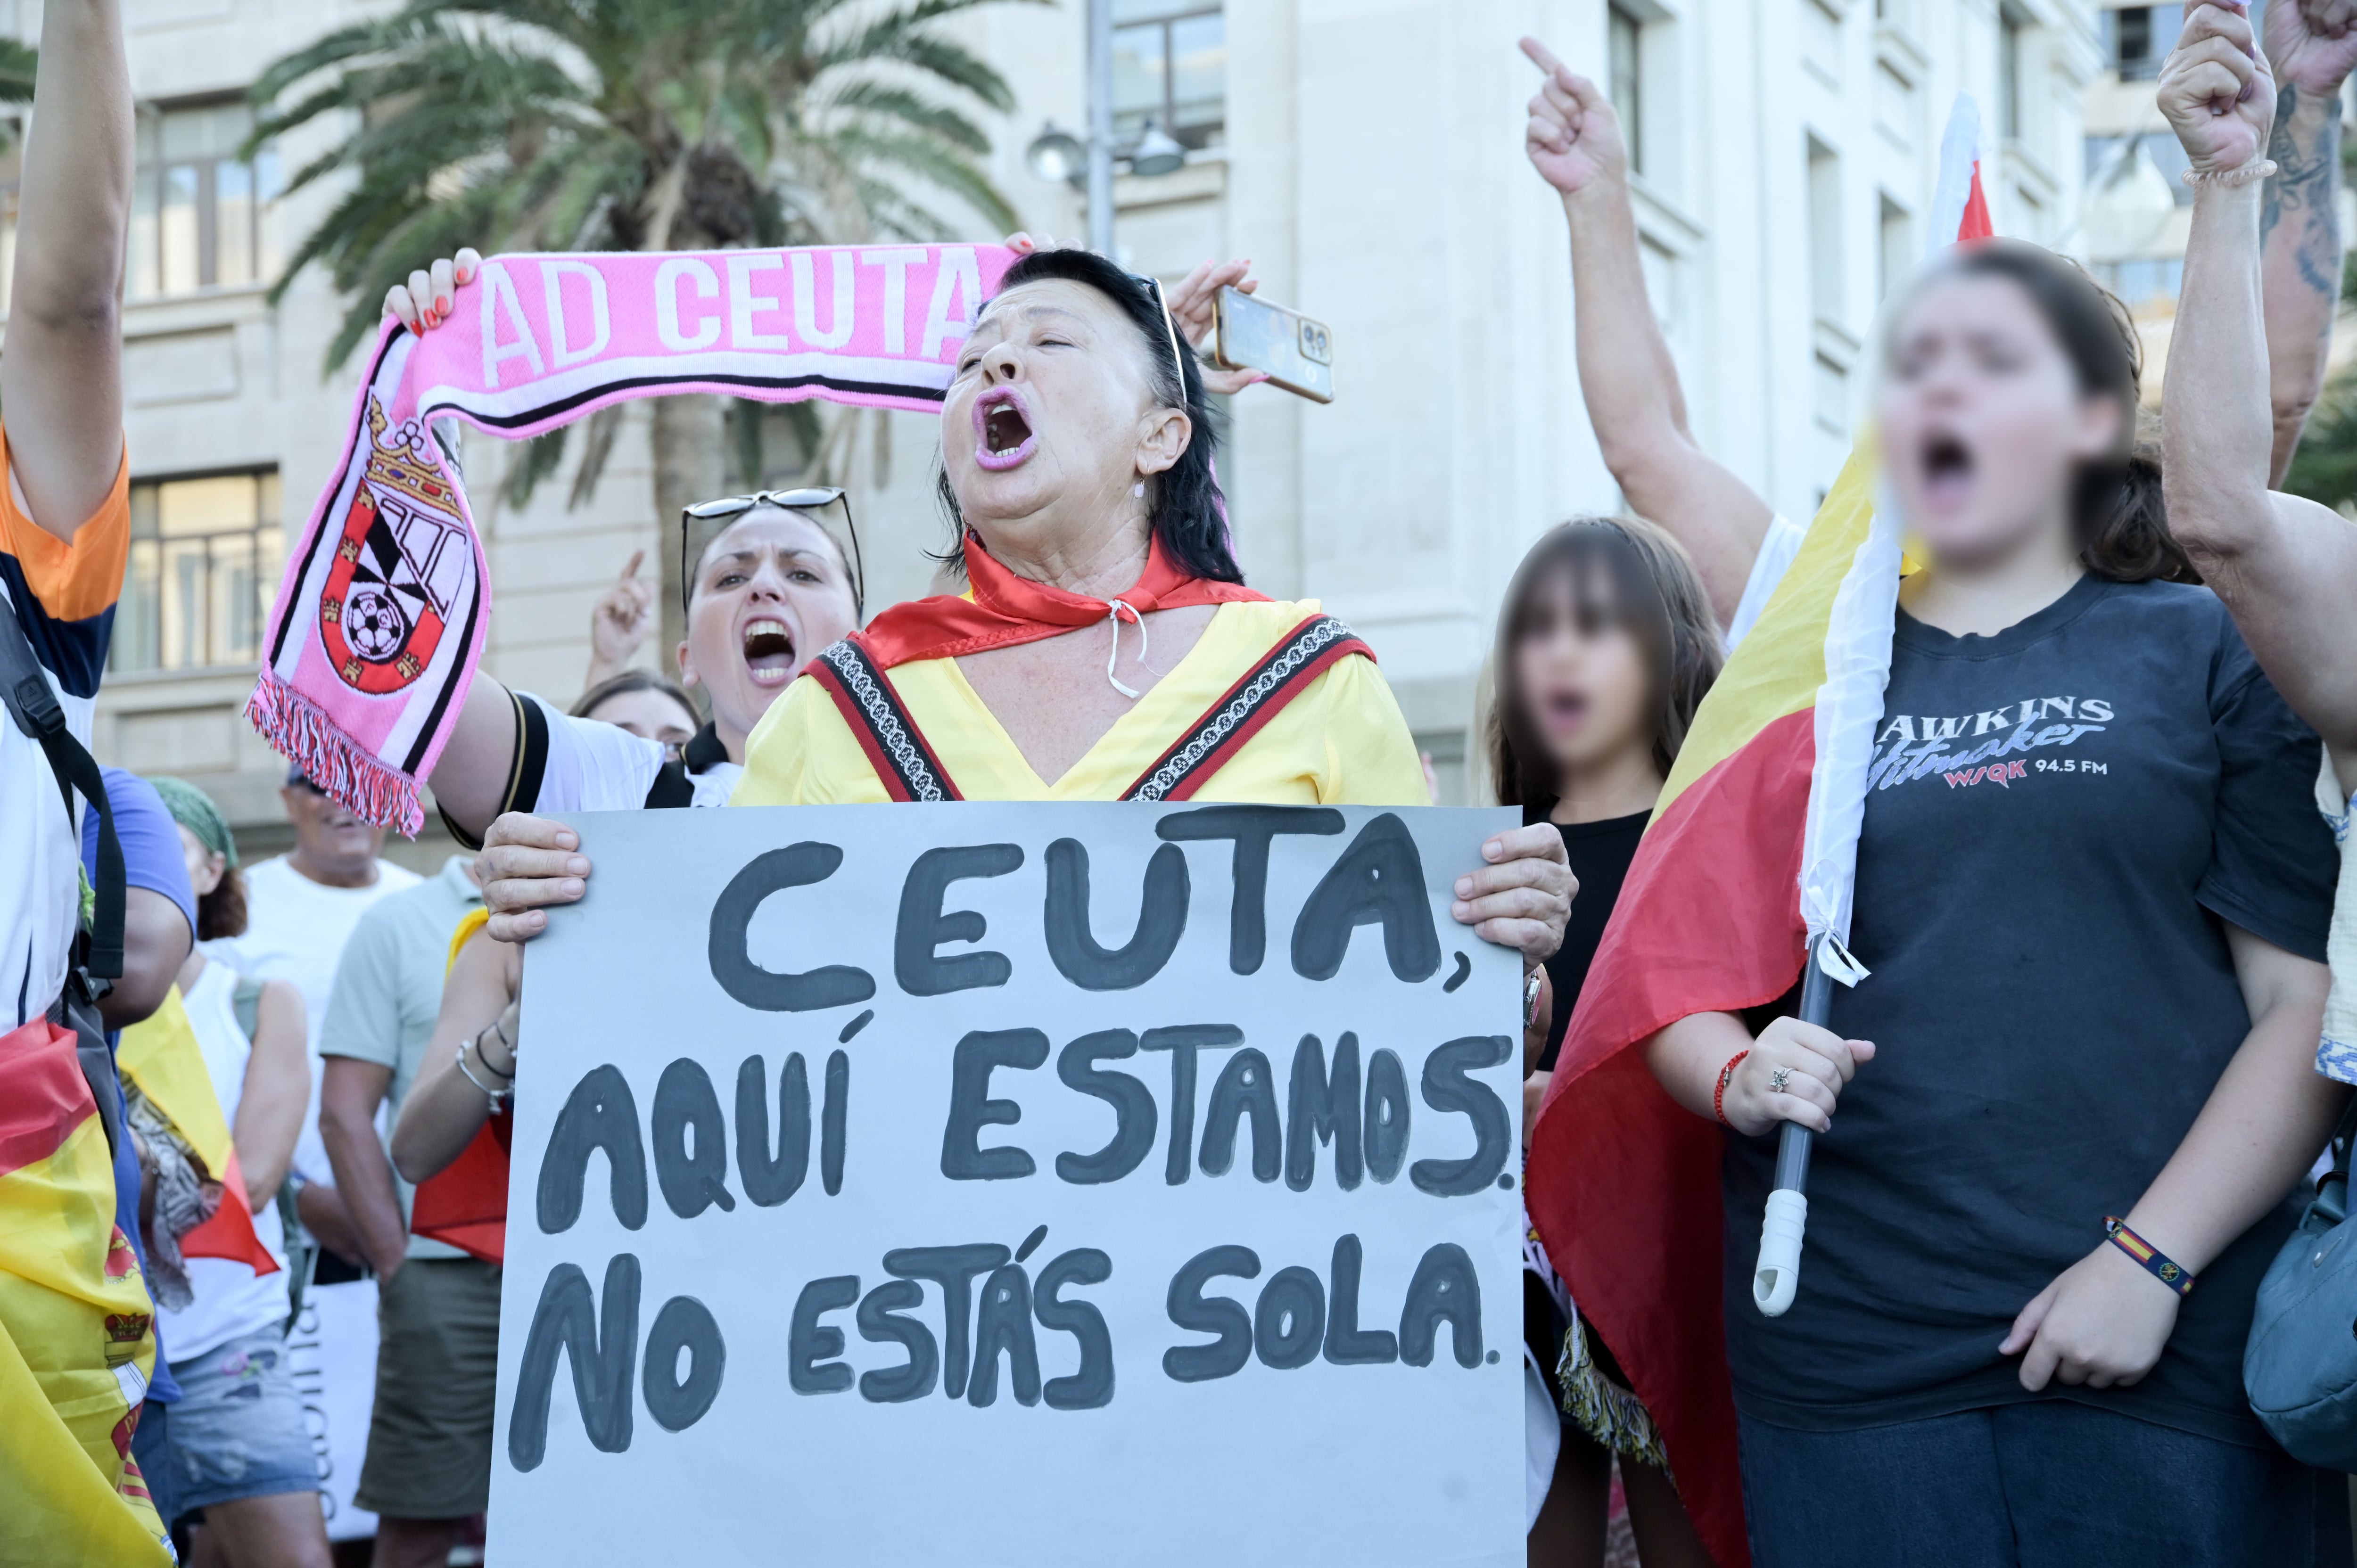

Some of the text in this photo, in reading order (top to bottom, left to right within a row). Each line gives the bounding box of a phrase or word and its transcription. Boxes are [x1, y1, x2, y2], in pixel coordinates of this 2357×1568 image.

[480, 246, 982, 388] AD CEUTA
[1875, 696, 2115, 743] AWKINS
[1944, 759, 2108, 789] WSQK 94.5 FM
[708, 803, 1472, 1013] CEUTA,
[536, 1009, 1515, 1235] AQUÍ ESTAMOS.
[507, 1224, 1501, 1474] NO ESTÁS SOLA.
